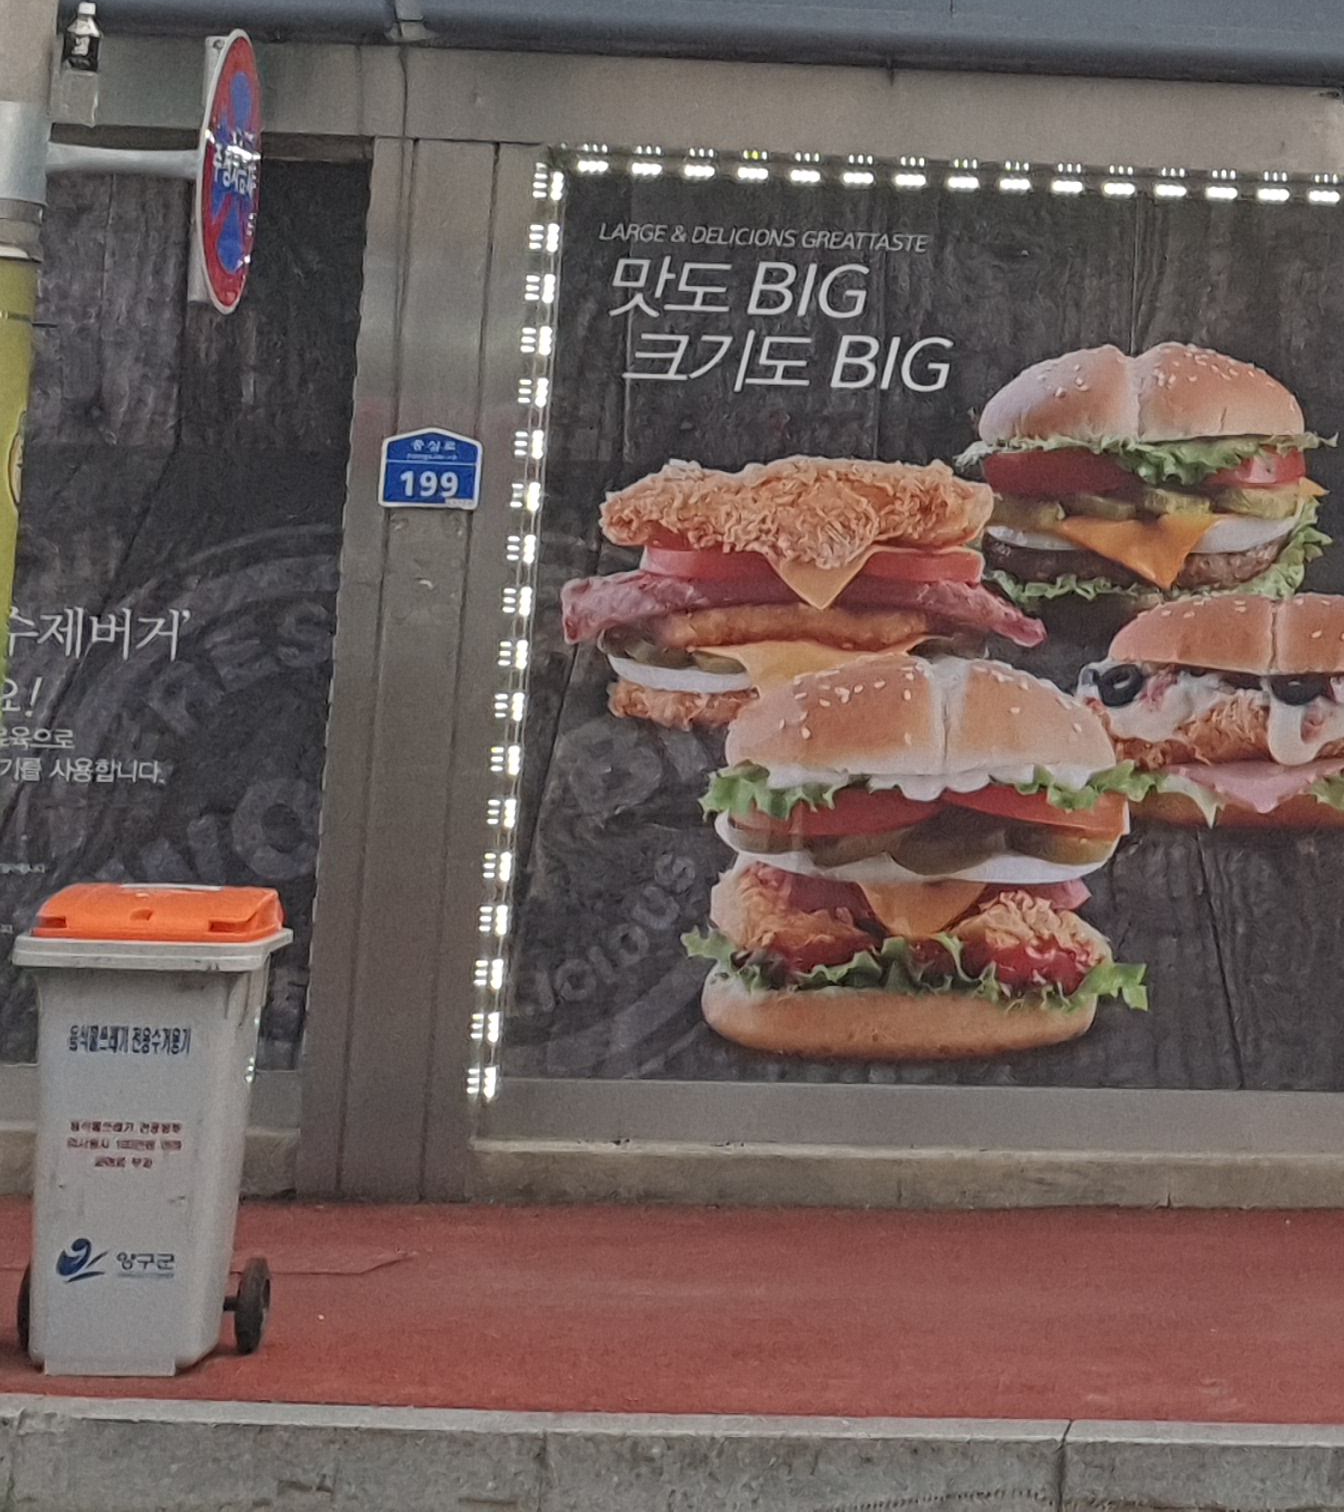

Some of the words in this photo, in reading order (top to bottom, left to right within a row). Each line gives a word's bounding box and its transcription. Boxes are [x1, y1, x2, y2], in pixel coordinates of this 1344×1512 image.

[599, 223, 666, 243] LARGE
[671, 225, 688, 244] &
[802, 231, 931, 254] GREATTASTE
[609, 256, 733, 319] 맛도
[747, 261, 871, 320] BIG
[622, 330, 812, 392] 크기도
[829, 334, 955, 394] BIG
[400, 470, 459, 499] 199
[116, 1251, 176, 1272] 양구군
